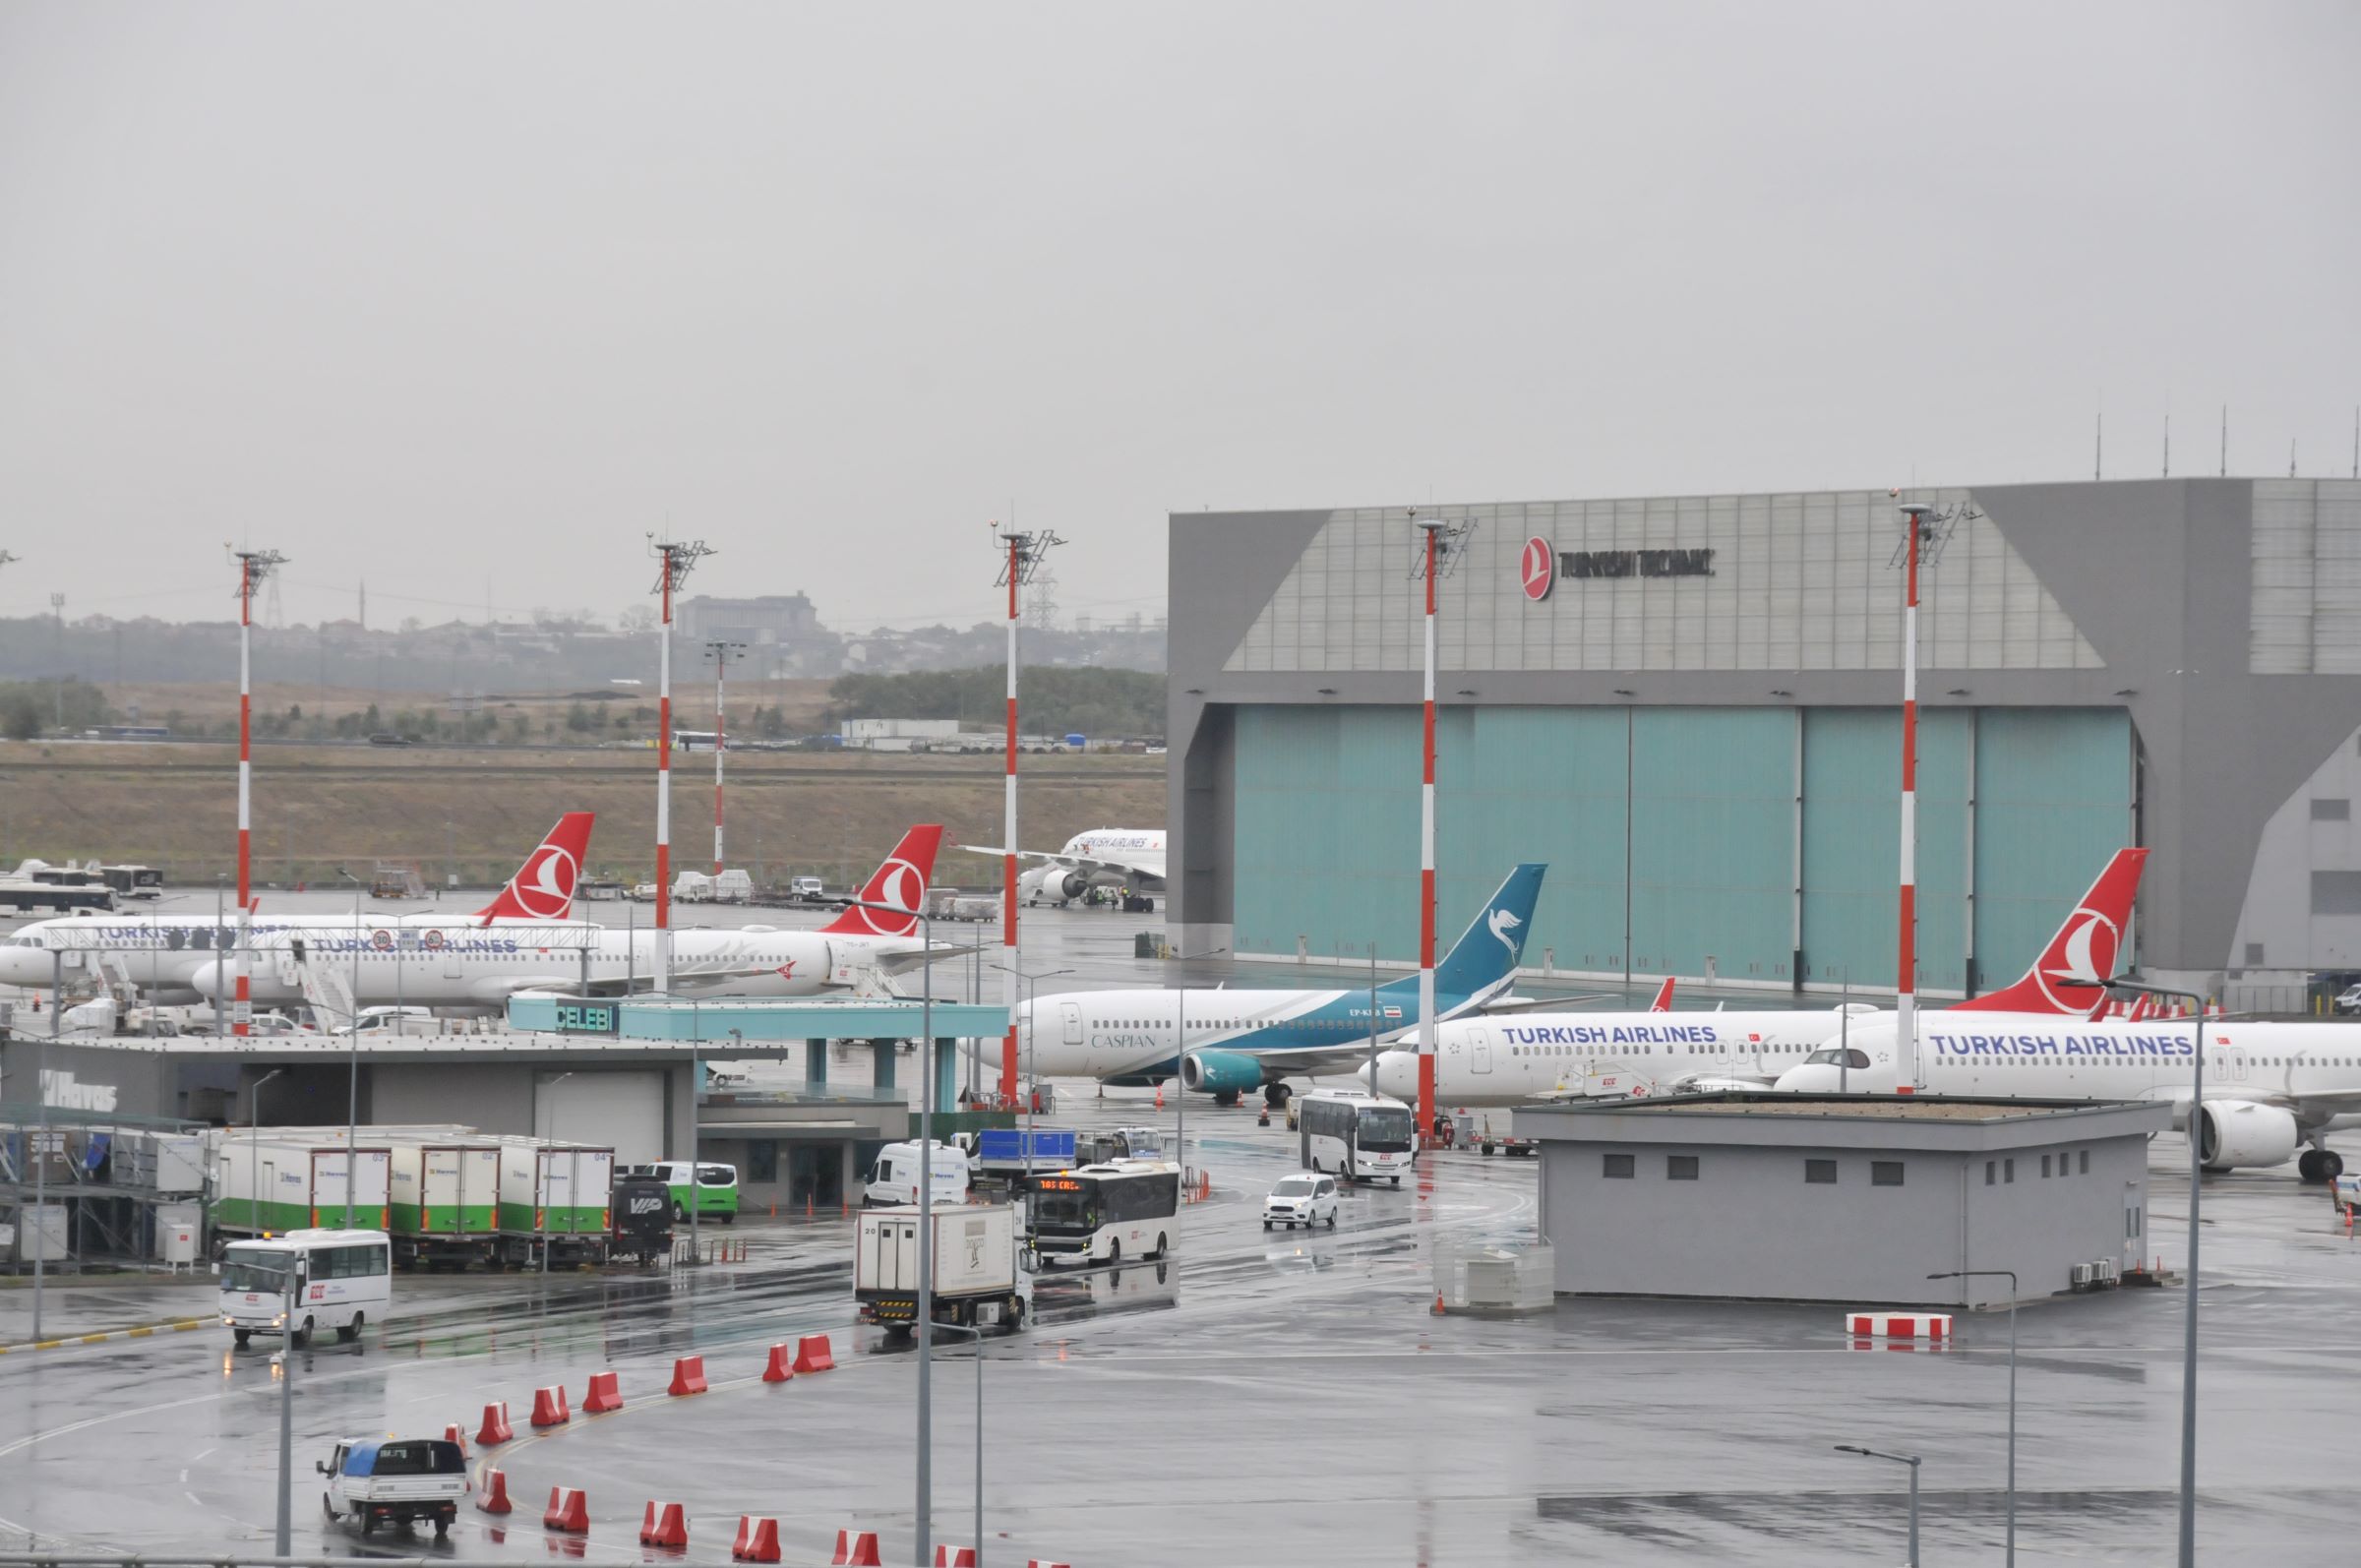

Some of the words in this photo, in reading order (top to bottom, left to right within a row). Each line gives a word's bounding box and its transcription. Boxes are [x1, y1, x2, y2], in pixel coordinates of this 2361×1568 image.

[1111, 837, 1148, 848] AIRLINES
[1091, 1034, 1156, 1048] CASPIAN
[1502, 1027, 1607, 1044] TURKISH
[1612, 1026, 1717, 1043] AIRLINES
[1929, 1036, 2059, 1055] TURKISH
[2065, 1036, 2194, 1055] AIRLINES
[594, 1153, 606, 1162] 04
[631, 1198, 663, 1214] VIP
